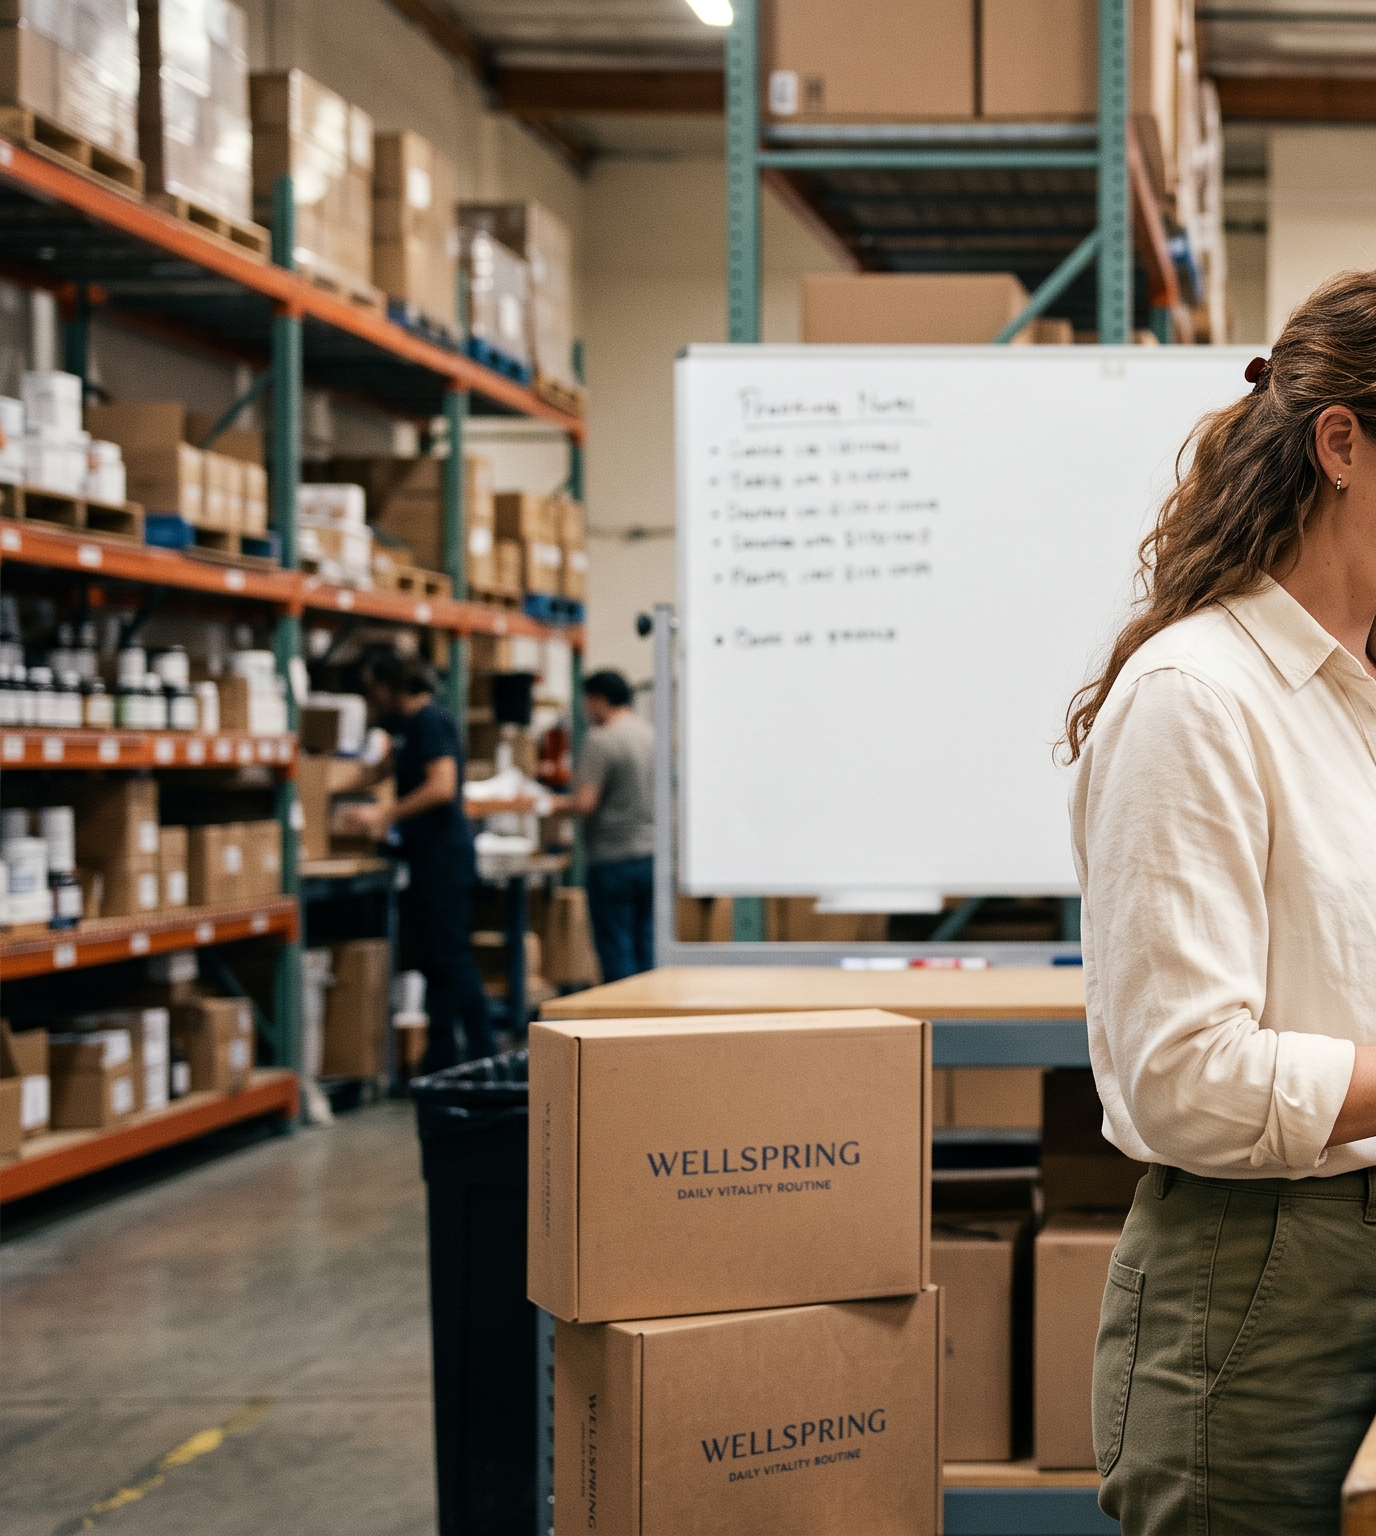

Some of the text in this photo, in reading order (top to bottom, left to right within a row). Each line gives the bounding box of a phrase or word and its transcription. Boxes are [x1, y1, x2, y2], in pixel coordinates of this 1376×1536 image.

[647, 1140, 860, 1177] WELLSPRING
[677, 1180, 831, 1200] DAILY VITALITY ROUTINE
[701, 1408, 886, 1463] WELLSPRING
[729, 1468, 760, 1483] DAILY
[764, 1458, 811, 1475] VITALITY
